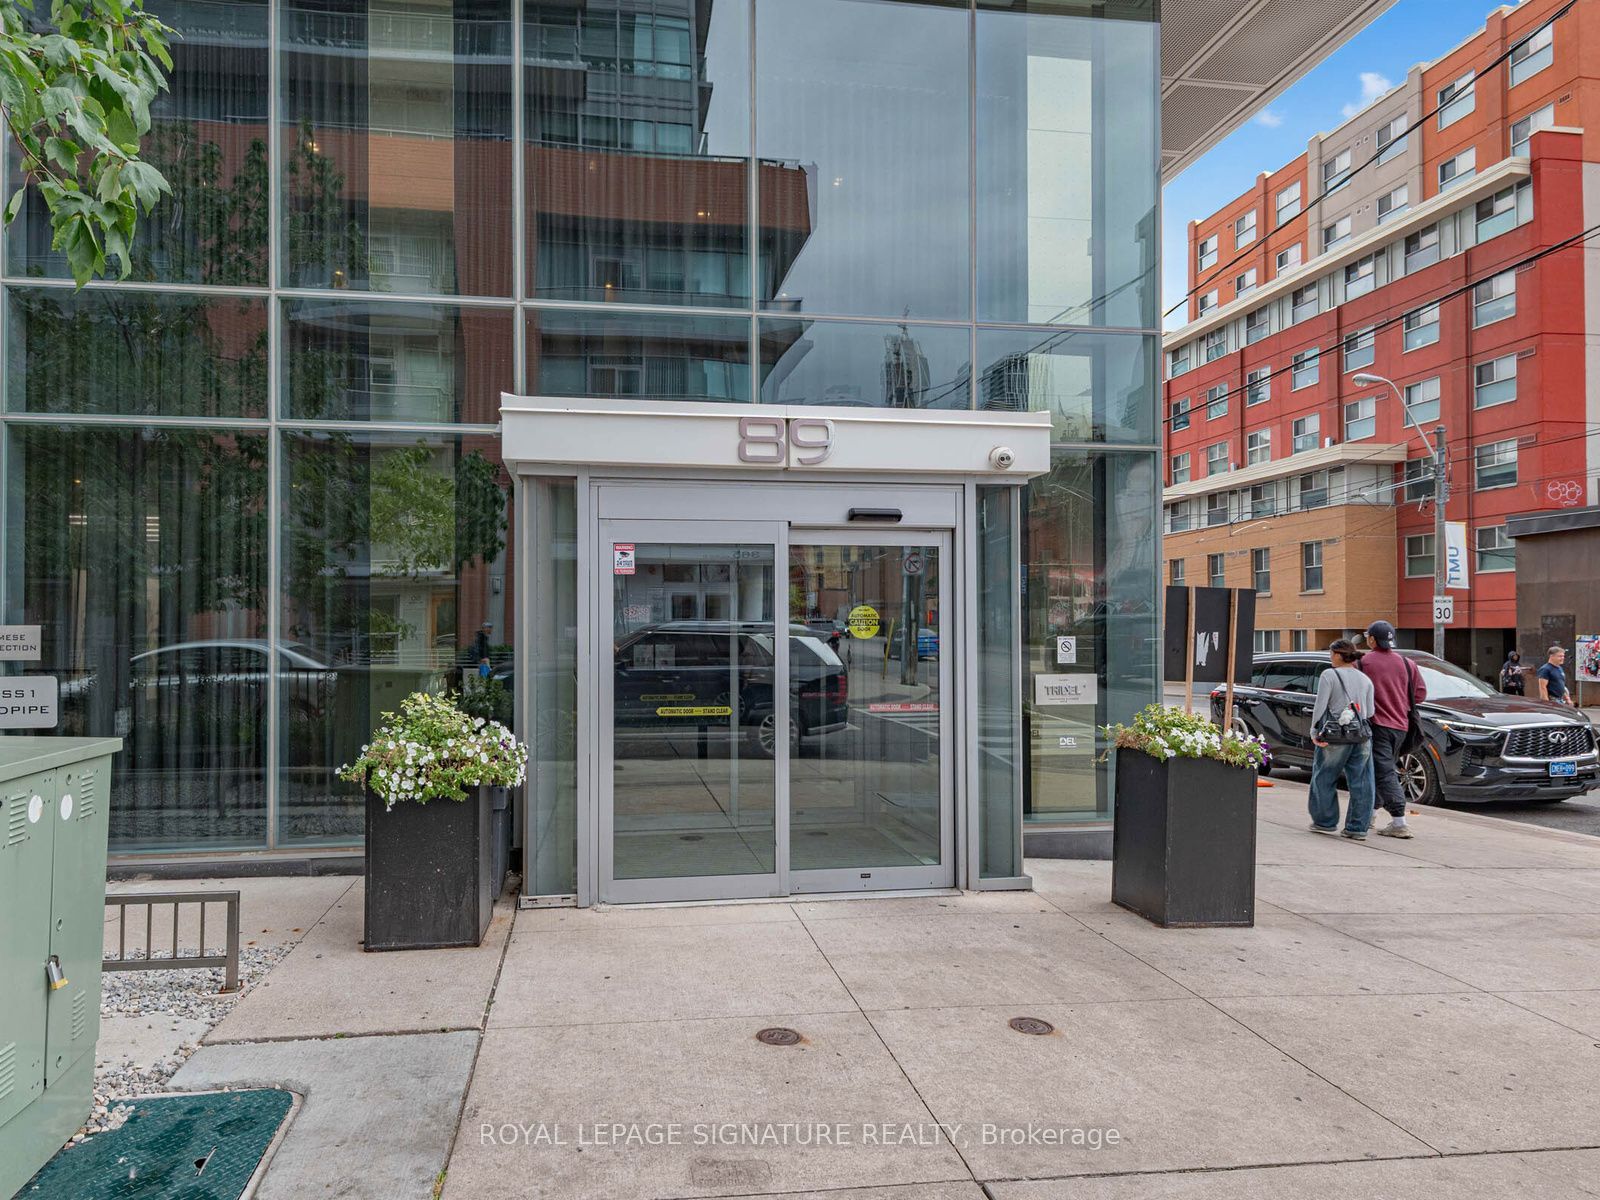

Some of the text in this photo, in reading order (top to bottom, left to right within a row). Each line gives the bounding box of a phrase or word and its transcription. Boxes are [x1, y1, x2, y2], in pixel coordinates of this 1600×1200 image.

[738, 417, 835, 465] 89
[1448, 546, 1461, 584] TMU
[1435, 607, 1451, 620] 30
[2, 689, 35, 698] SS 1
